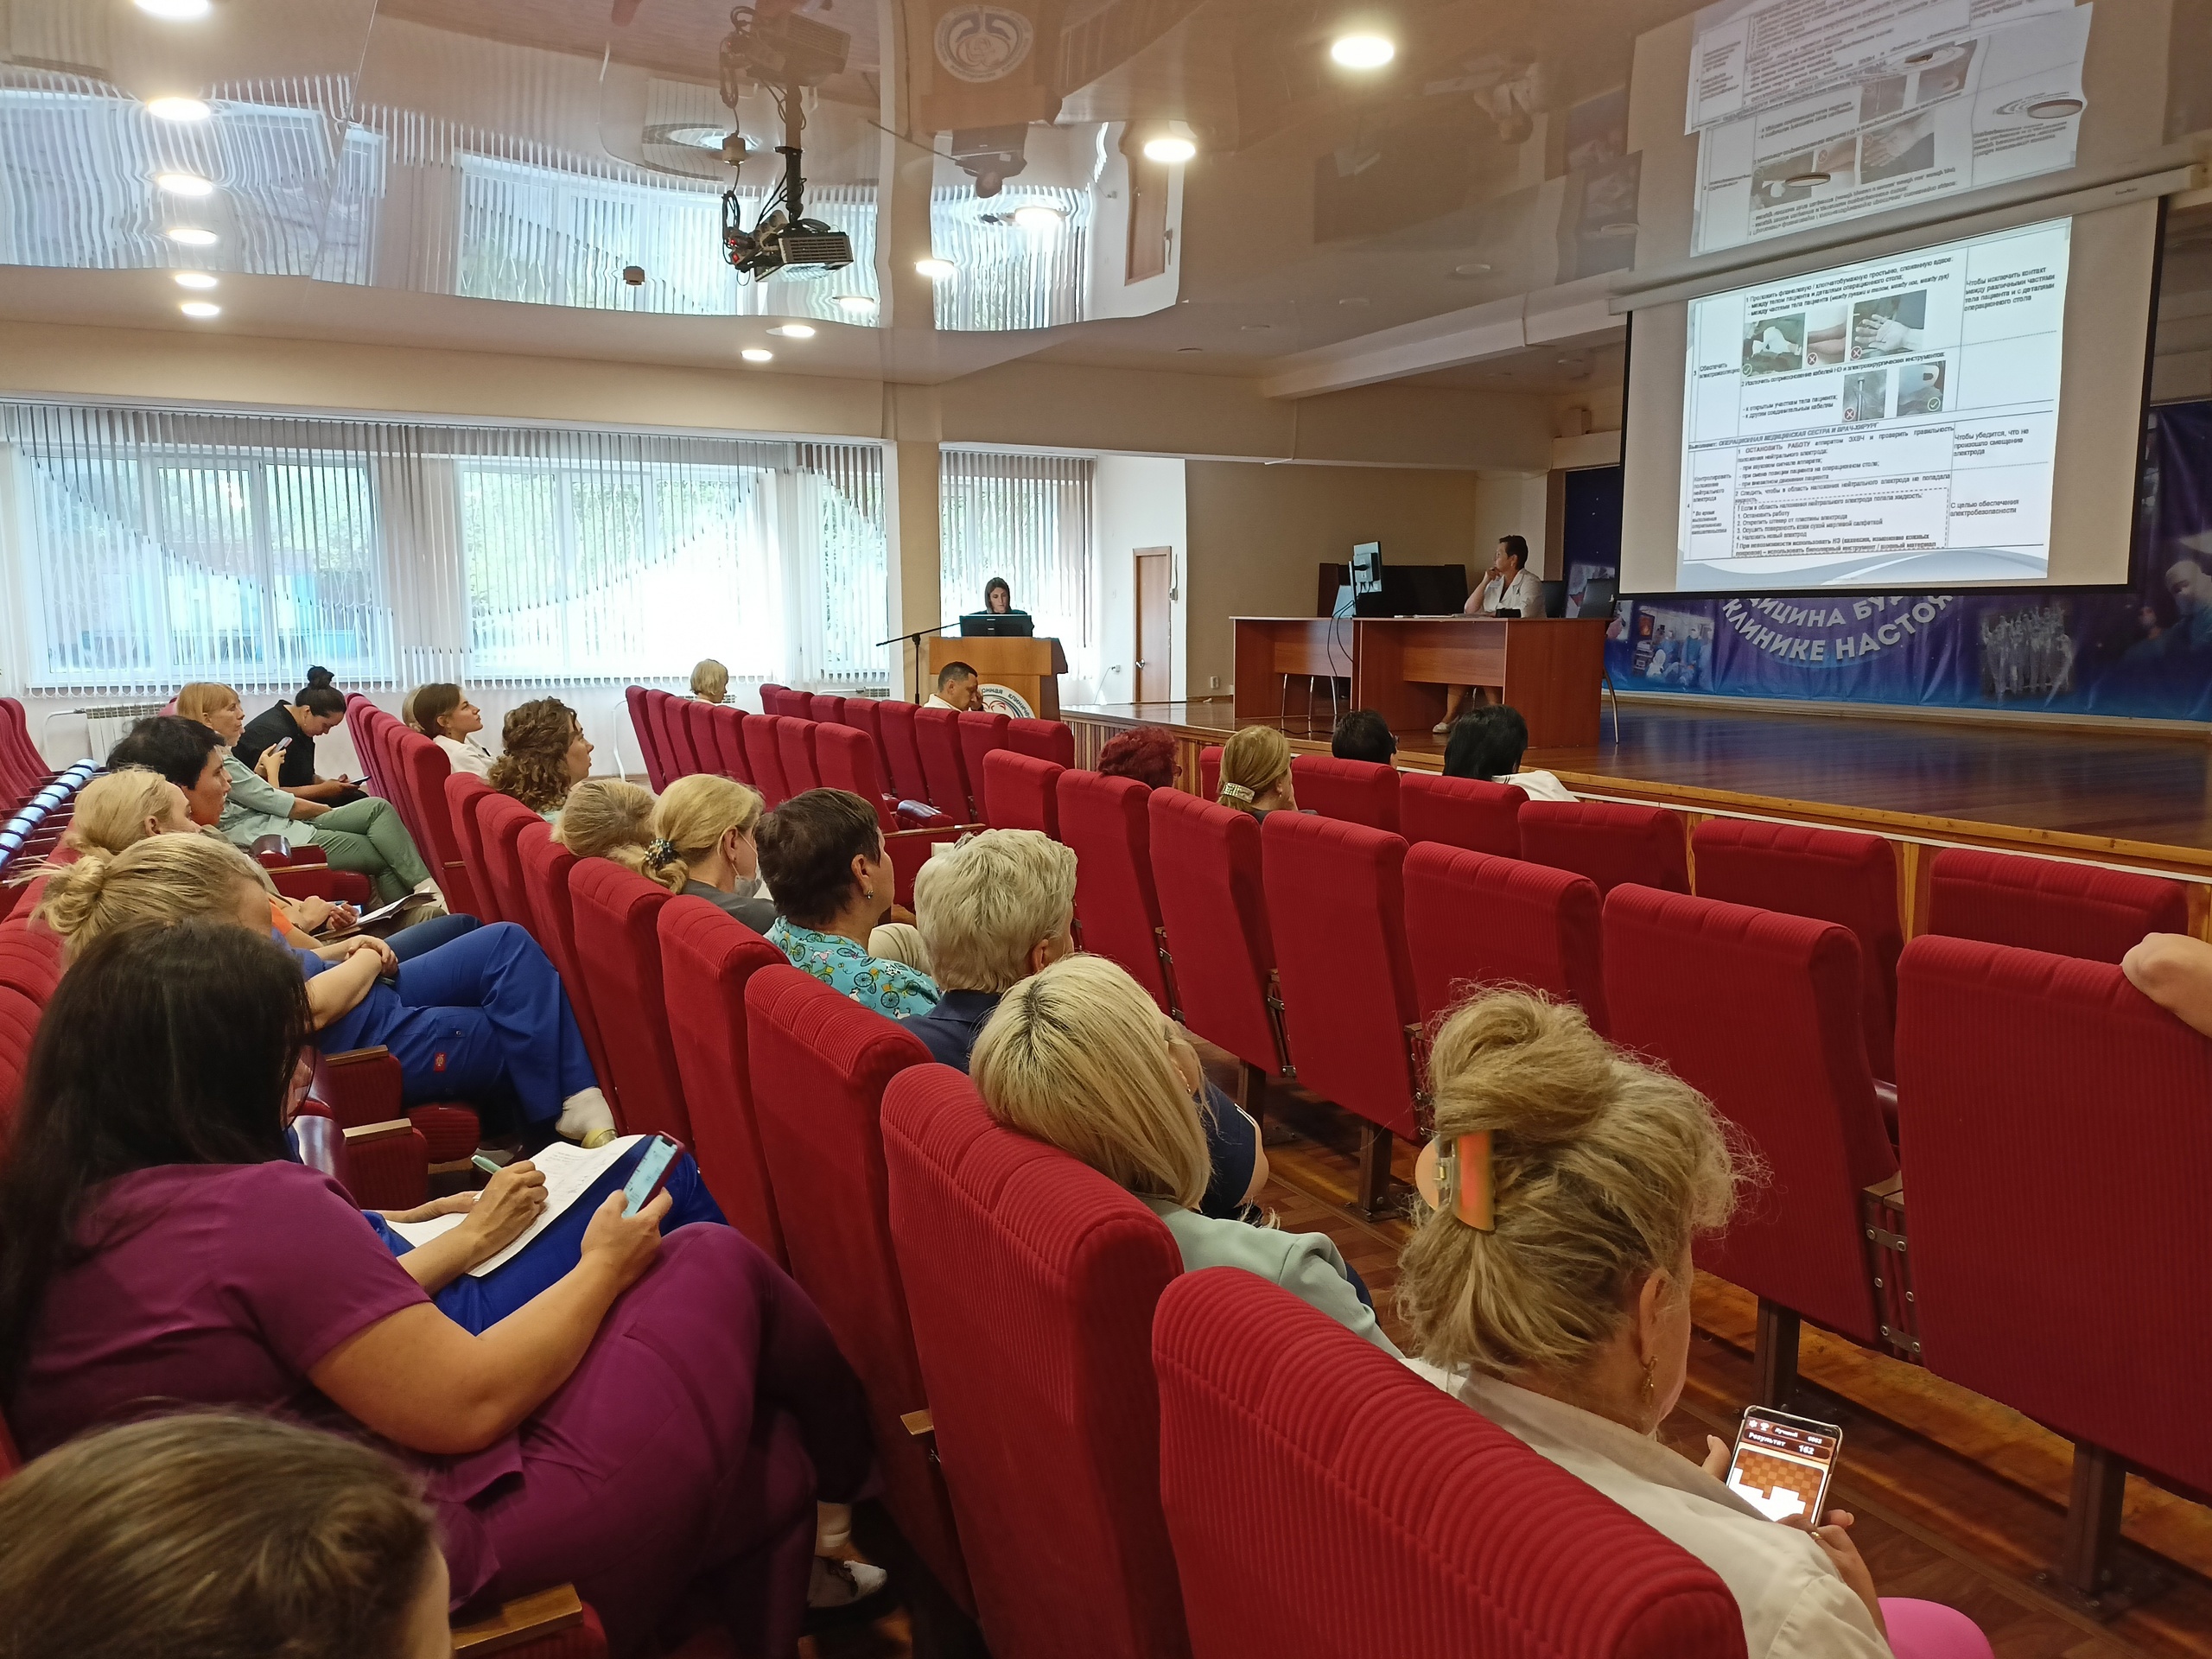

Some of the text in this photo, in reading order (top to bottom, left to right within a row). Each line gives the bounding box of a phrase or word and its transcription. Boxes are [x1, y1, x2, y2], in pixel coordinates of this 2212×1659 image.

[1966, 267, 2046, 287] Чтобы исключить контакт
[1966, 274, 2055, 295] между различными частями
[1786, 293, 1809, 302] пациента
[1804, 296, 1828, 306] пациента
[1980, 290, 2010, 301] пациента
[2023, 283, 2055, 294] деталями
[1722, 598, 1826, 661] КЛИНИКЕ
[1748, 1432, 1815, 1455] Результат 162
